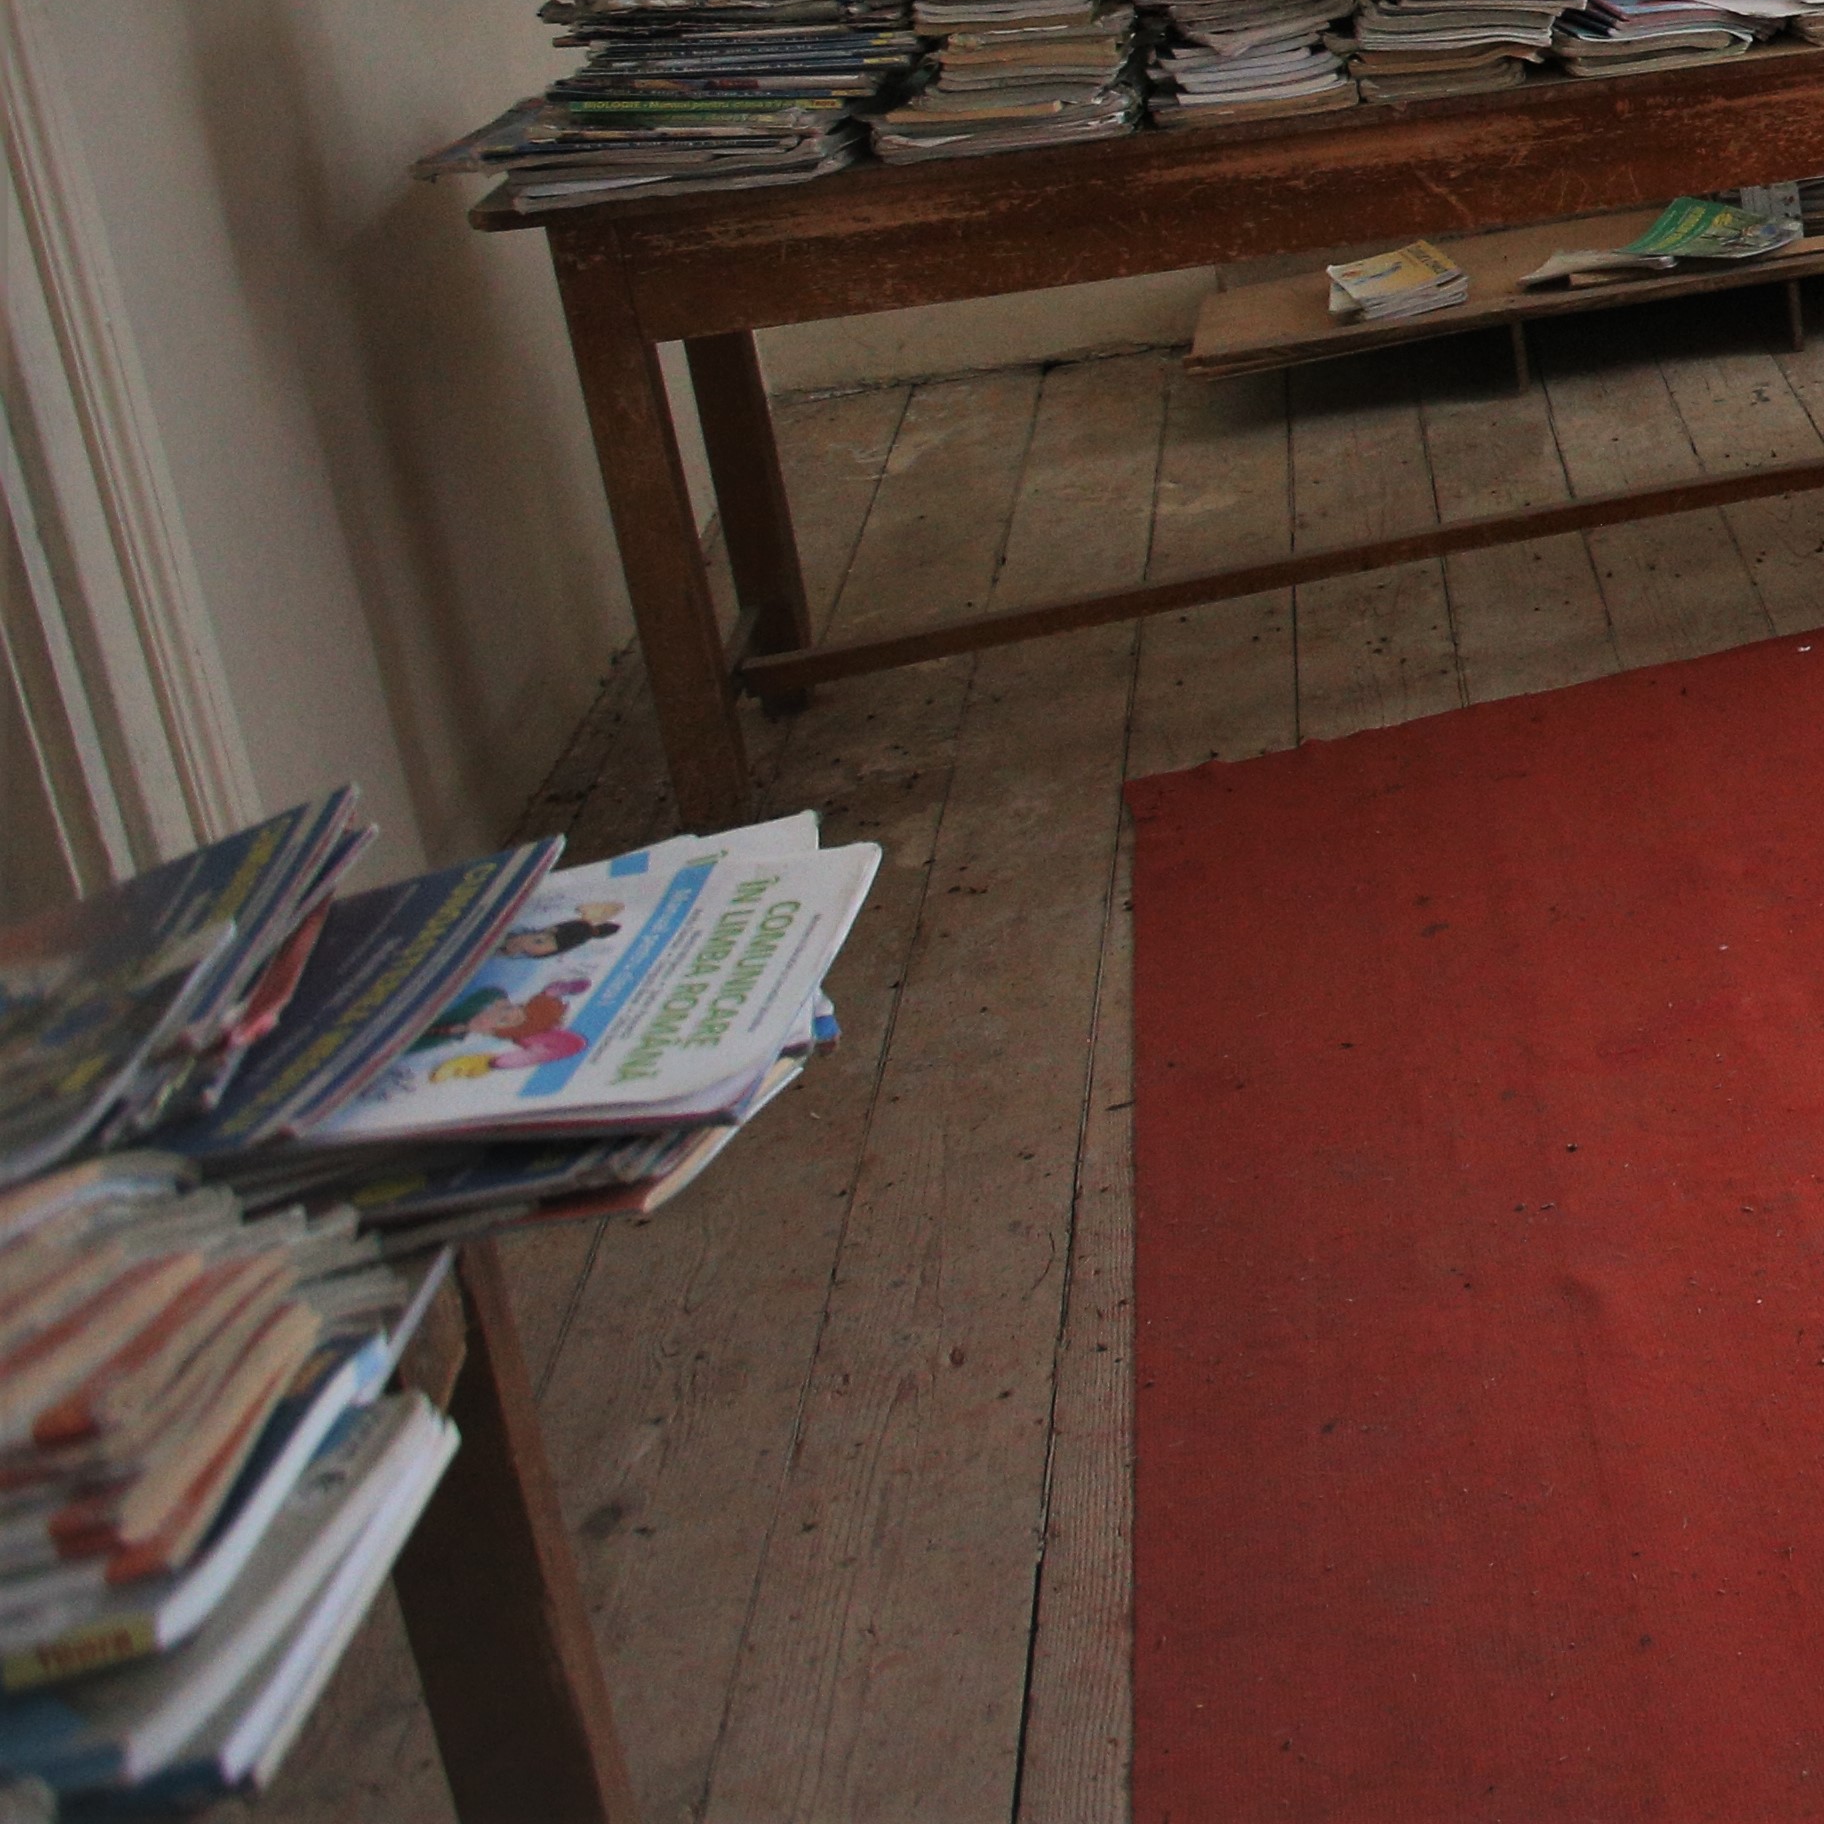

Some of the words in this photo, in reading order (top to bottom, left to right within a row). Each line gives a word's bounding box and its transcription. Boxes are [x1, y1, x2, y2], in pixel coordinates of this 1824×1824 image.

[731, 875, 781, 904] ÎN
[681, 900, 801, 1049] COMUNICARE
[682, 908, 754, 978] LIMBA
[609, 982, 709, 1086] ROMÂNĂ
